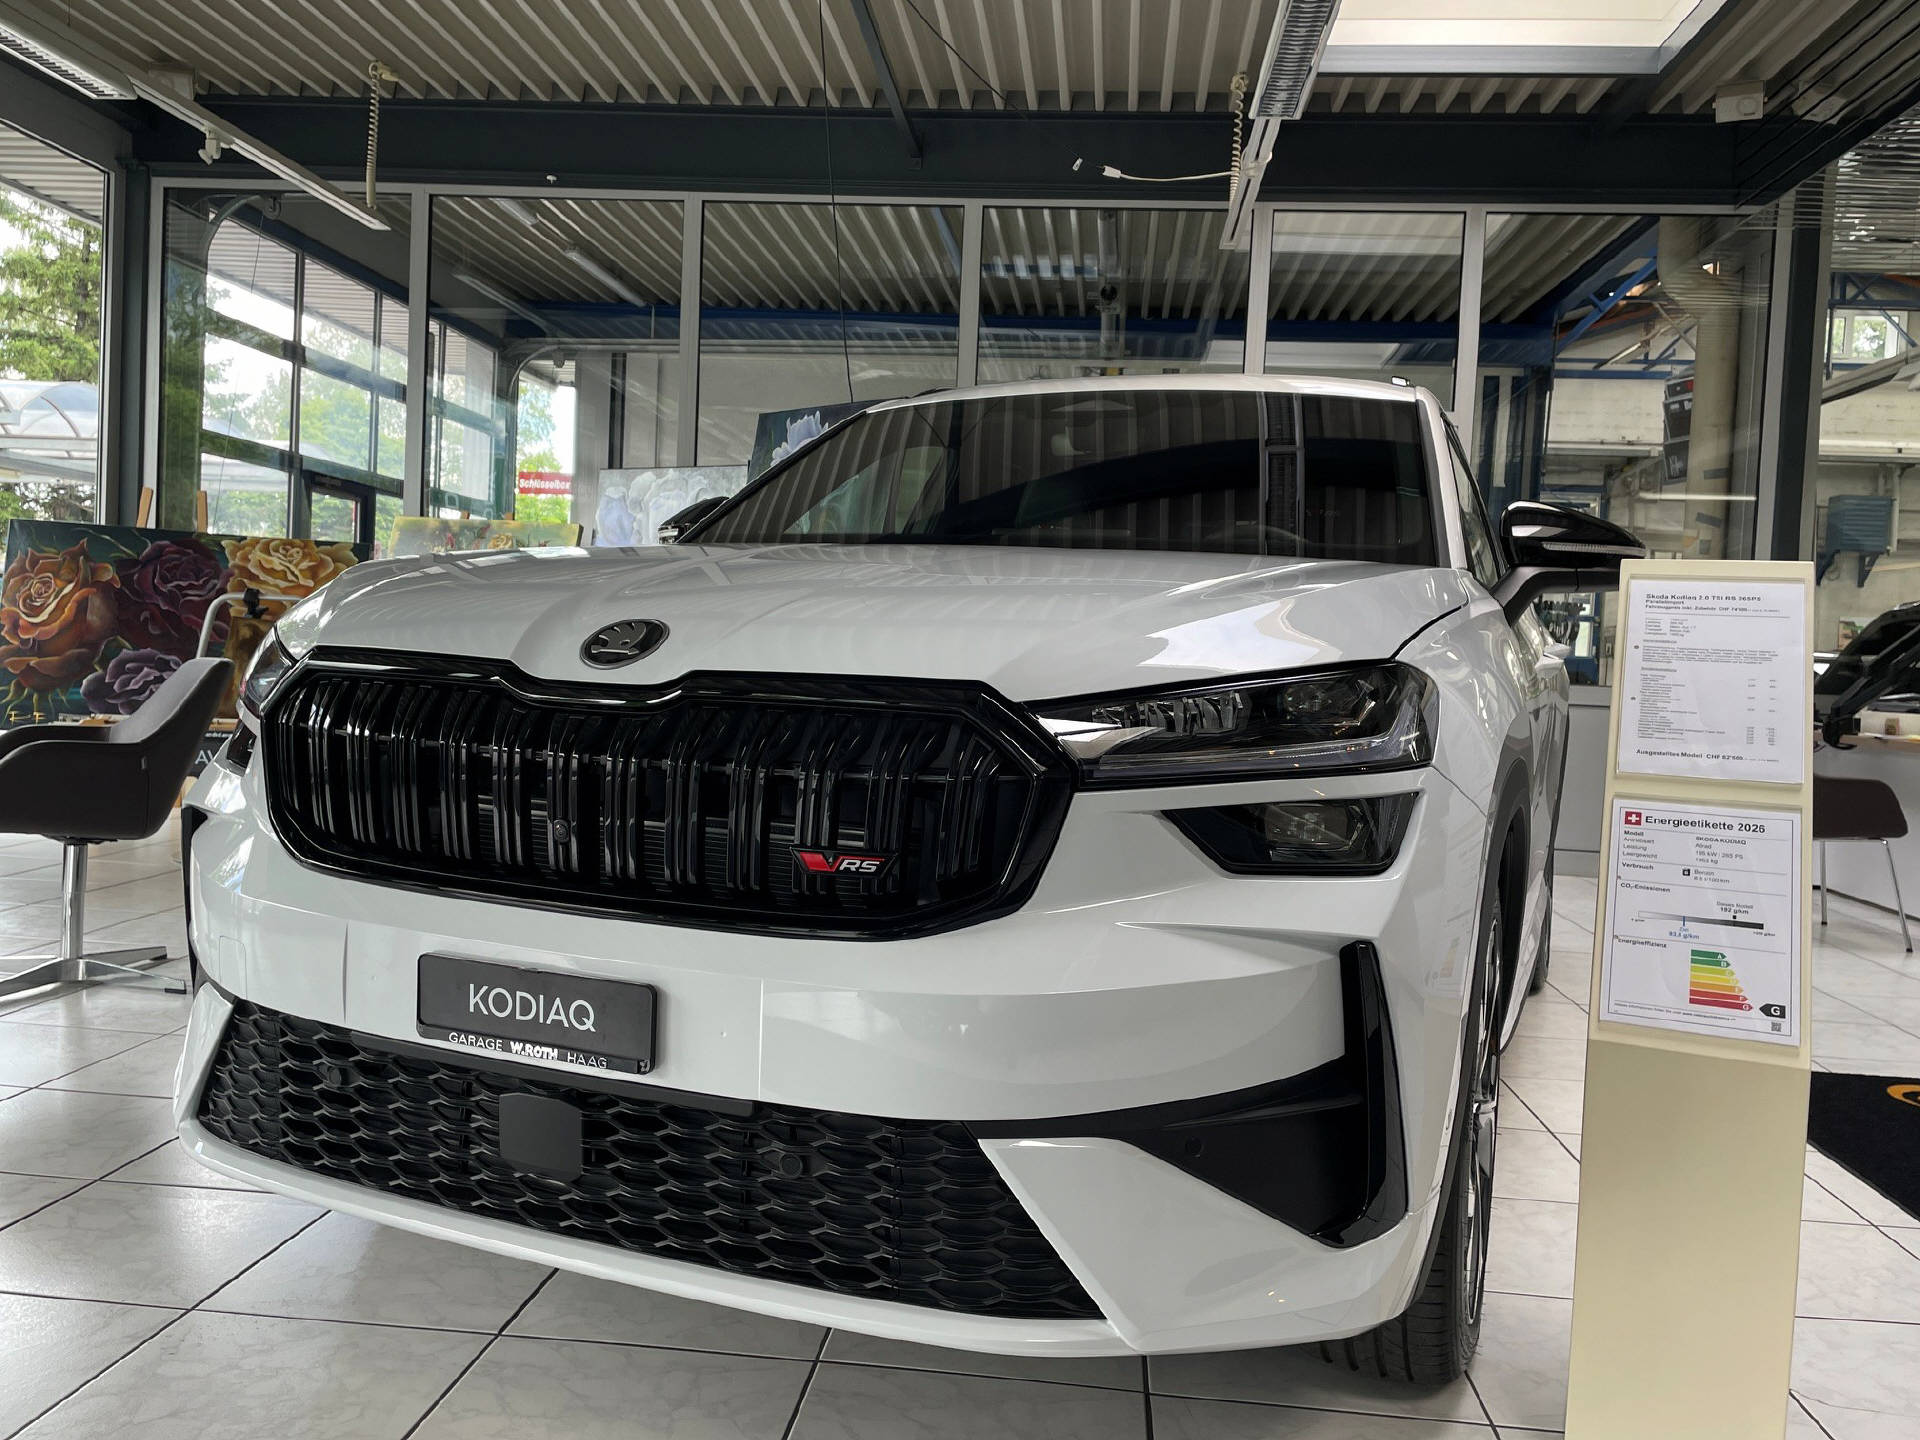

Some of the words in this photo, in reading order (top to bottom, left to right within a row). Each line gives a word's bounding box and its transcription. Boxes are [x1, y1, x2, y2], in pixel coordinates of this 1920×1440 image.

[1645, 815, 1734, 831] Energieetikette
[1737, 822, 1767, 834] 2026
[468, 983, 597, 1033] KODIAQ
[1770, 1005, 1781, 1017] G
[448, 1031, 504, 1052] GARAGE
[510, 1040, 559, 1061] W.ROTH
[567, 1051, 609, 1070] HAAG
